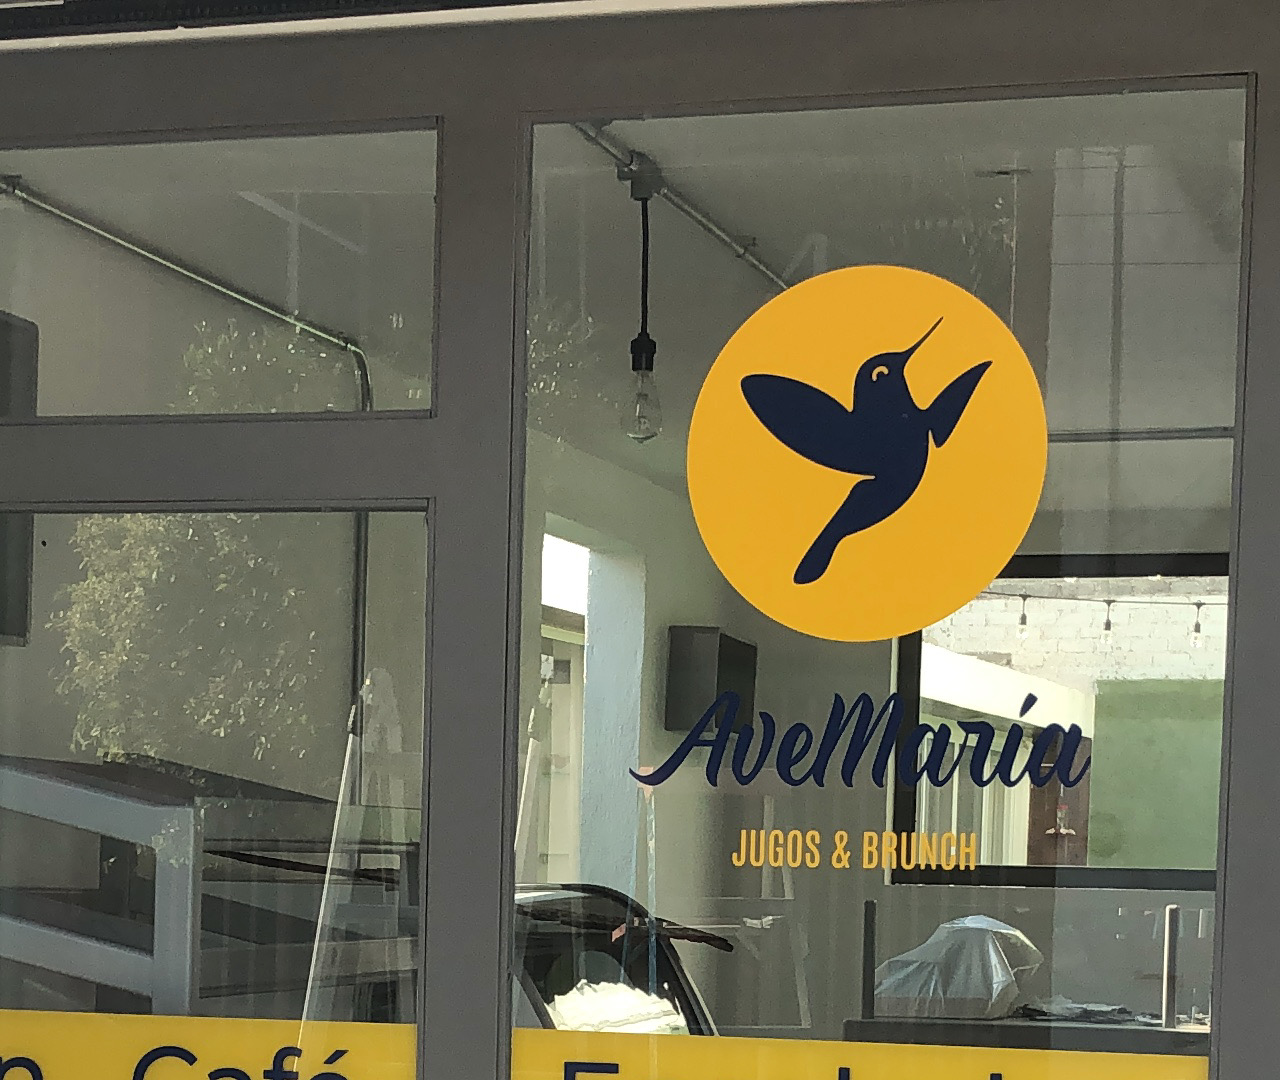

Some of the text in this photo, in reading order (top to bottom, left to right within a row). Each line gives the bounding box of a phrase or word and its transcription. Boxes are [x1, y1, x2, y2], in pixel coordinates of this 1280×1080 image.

[629, 690, 1092, 788] AveMaría
[731, 827, 977, 872] JUGOS & BRUNCH
